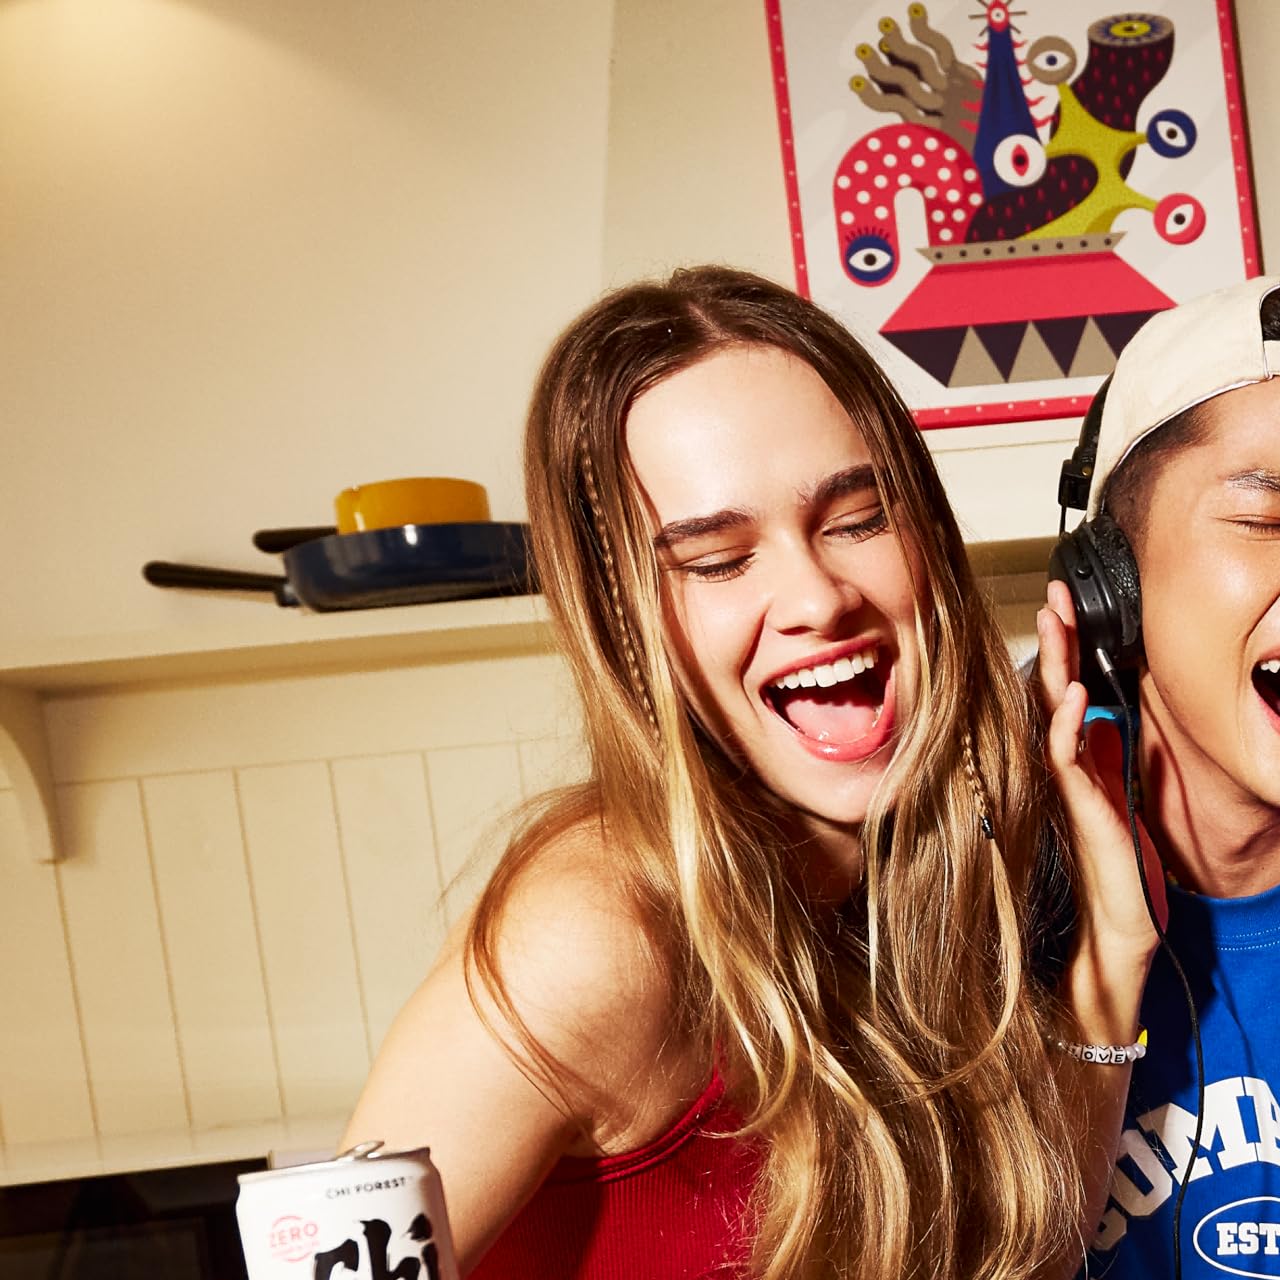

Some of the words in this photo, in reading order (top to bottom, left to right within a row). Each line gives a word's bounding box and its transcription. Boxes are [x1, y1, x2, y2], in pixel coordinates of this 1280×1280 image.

[1084, 1051, 1124, 1063] OVE
[355, 1176, 406, 1193] FOREST
[270, 1222, 319, 1248] ZERO
